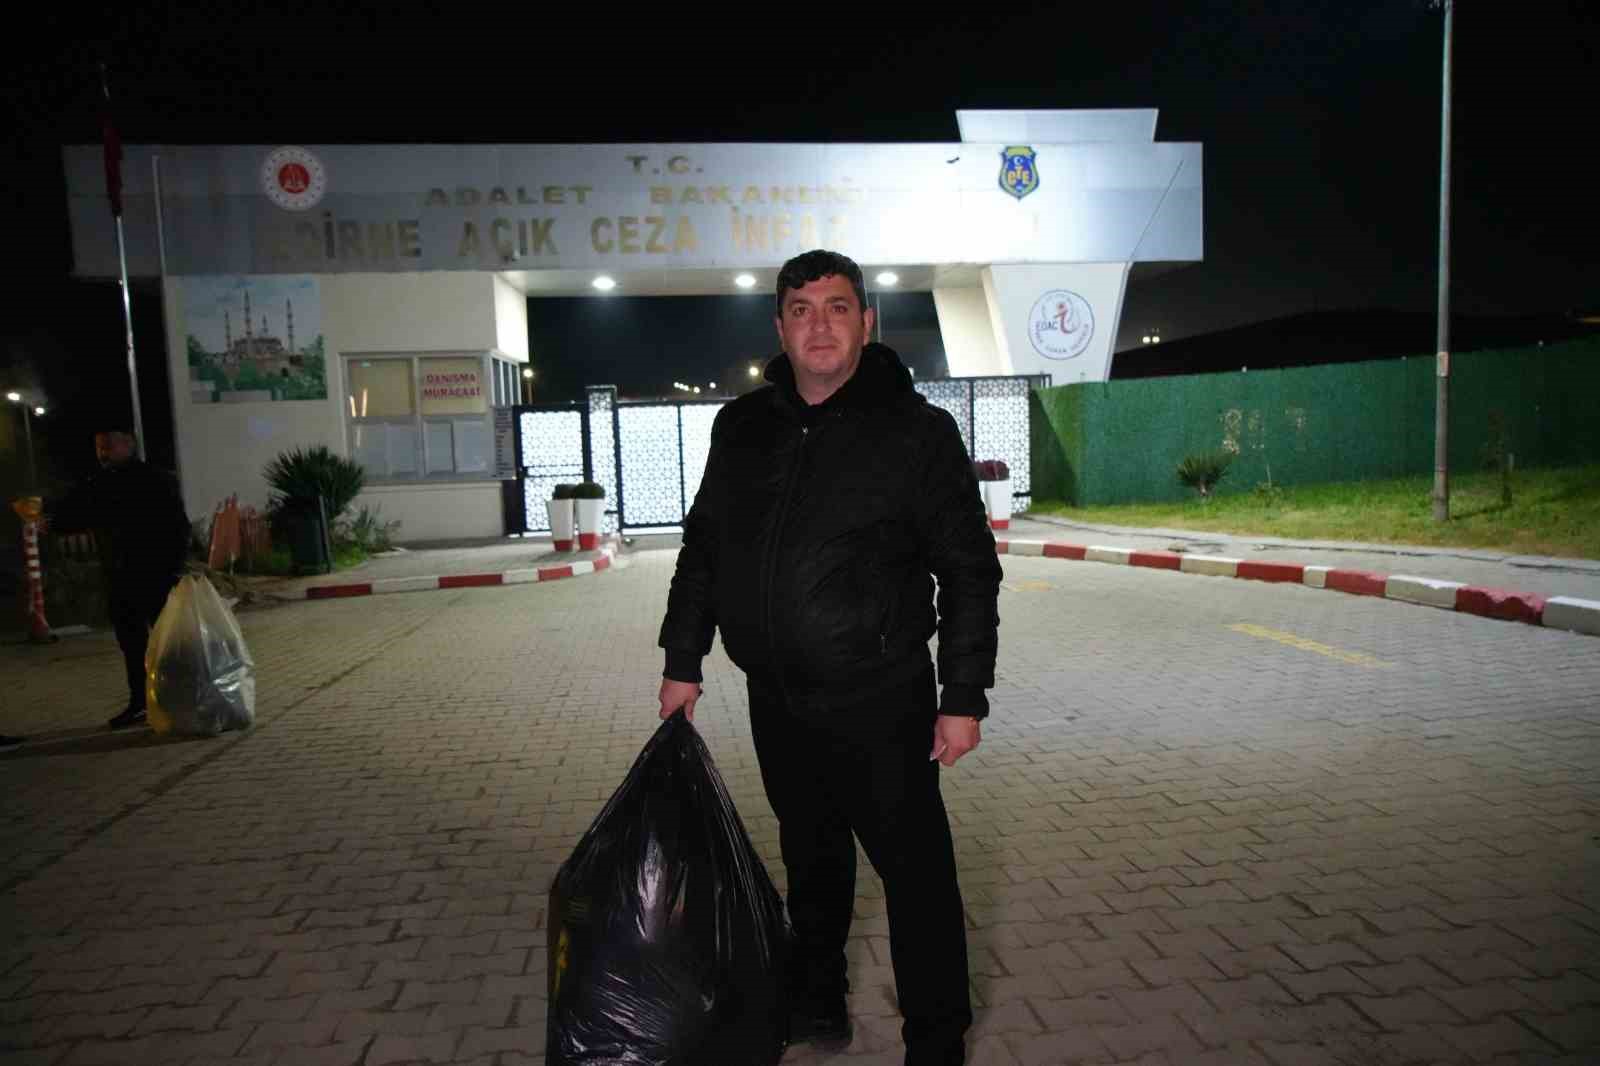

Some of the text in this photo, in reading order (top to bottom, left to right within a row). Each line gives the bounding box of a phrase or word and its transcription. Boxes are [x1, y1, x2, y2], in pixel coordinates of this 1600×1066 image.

[624, 155, 705, 174] T.C.
[424, 186, 593, 206] ADALET
[274, 210, 422, 259] DİRNE
[456, 217, 558, 264] AÇIK
[590, 215, 698, 254] CEZA
